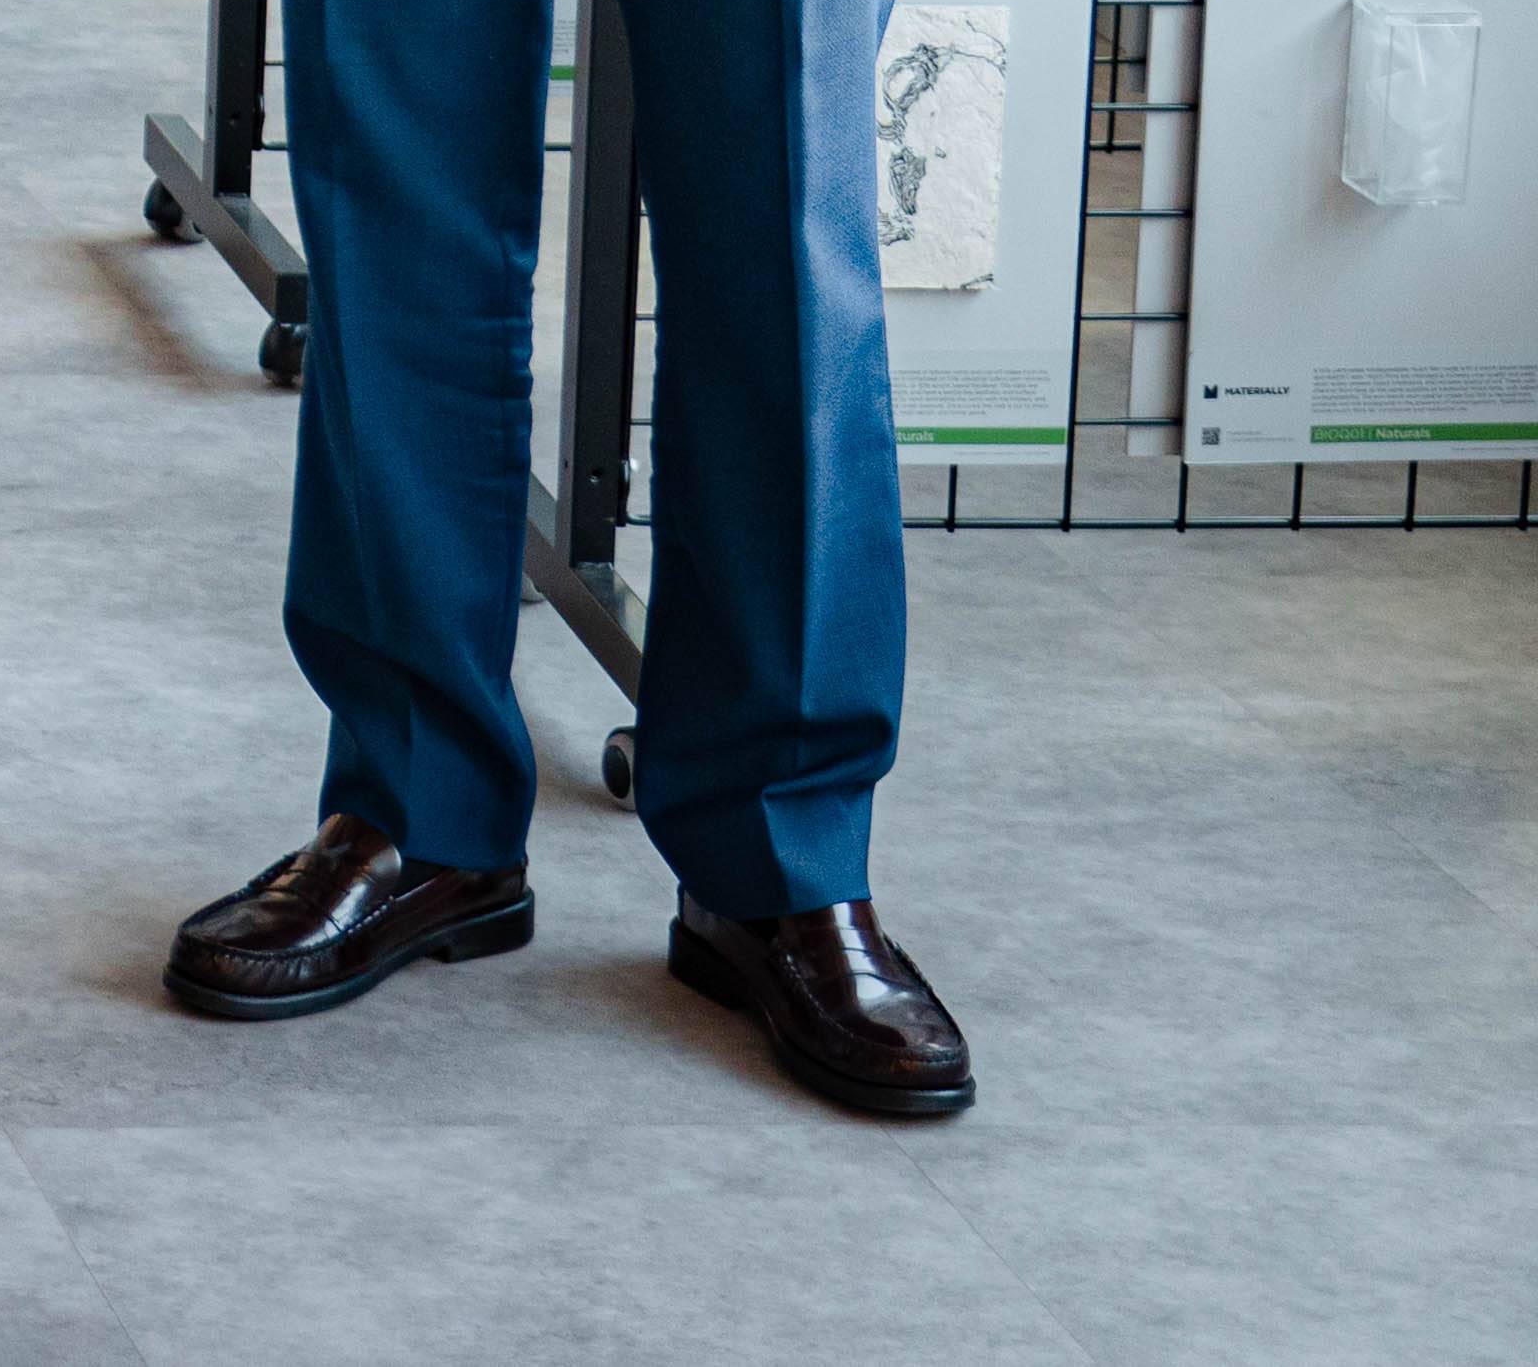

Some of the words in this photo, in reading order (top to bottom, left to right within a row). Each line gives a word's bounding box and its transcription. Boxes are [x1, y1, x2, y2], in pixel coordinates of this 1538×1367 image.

[1224, 386, 1290, 395] MATERIALLY
[896, 430, 934, 442] turals
[1375, 427, 1431, 439] Naturals
